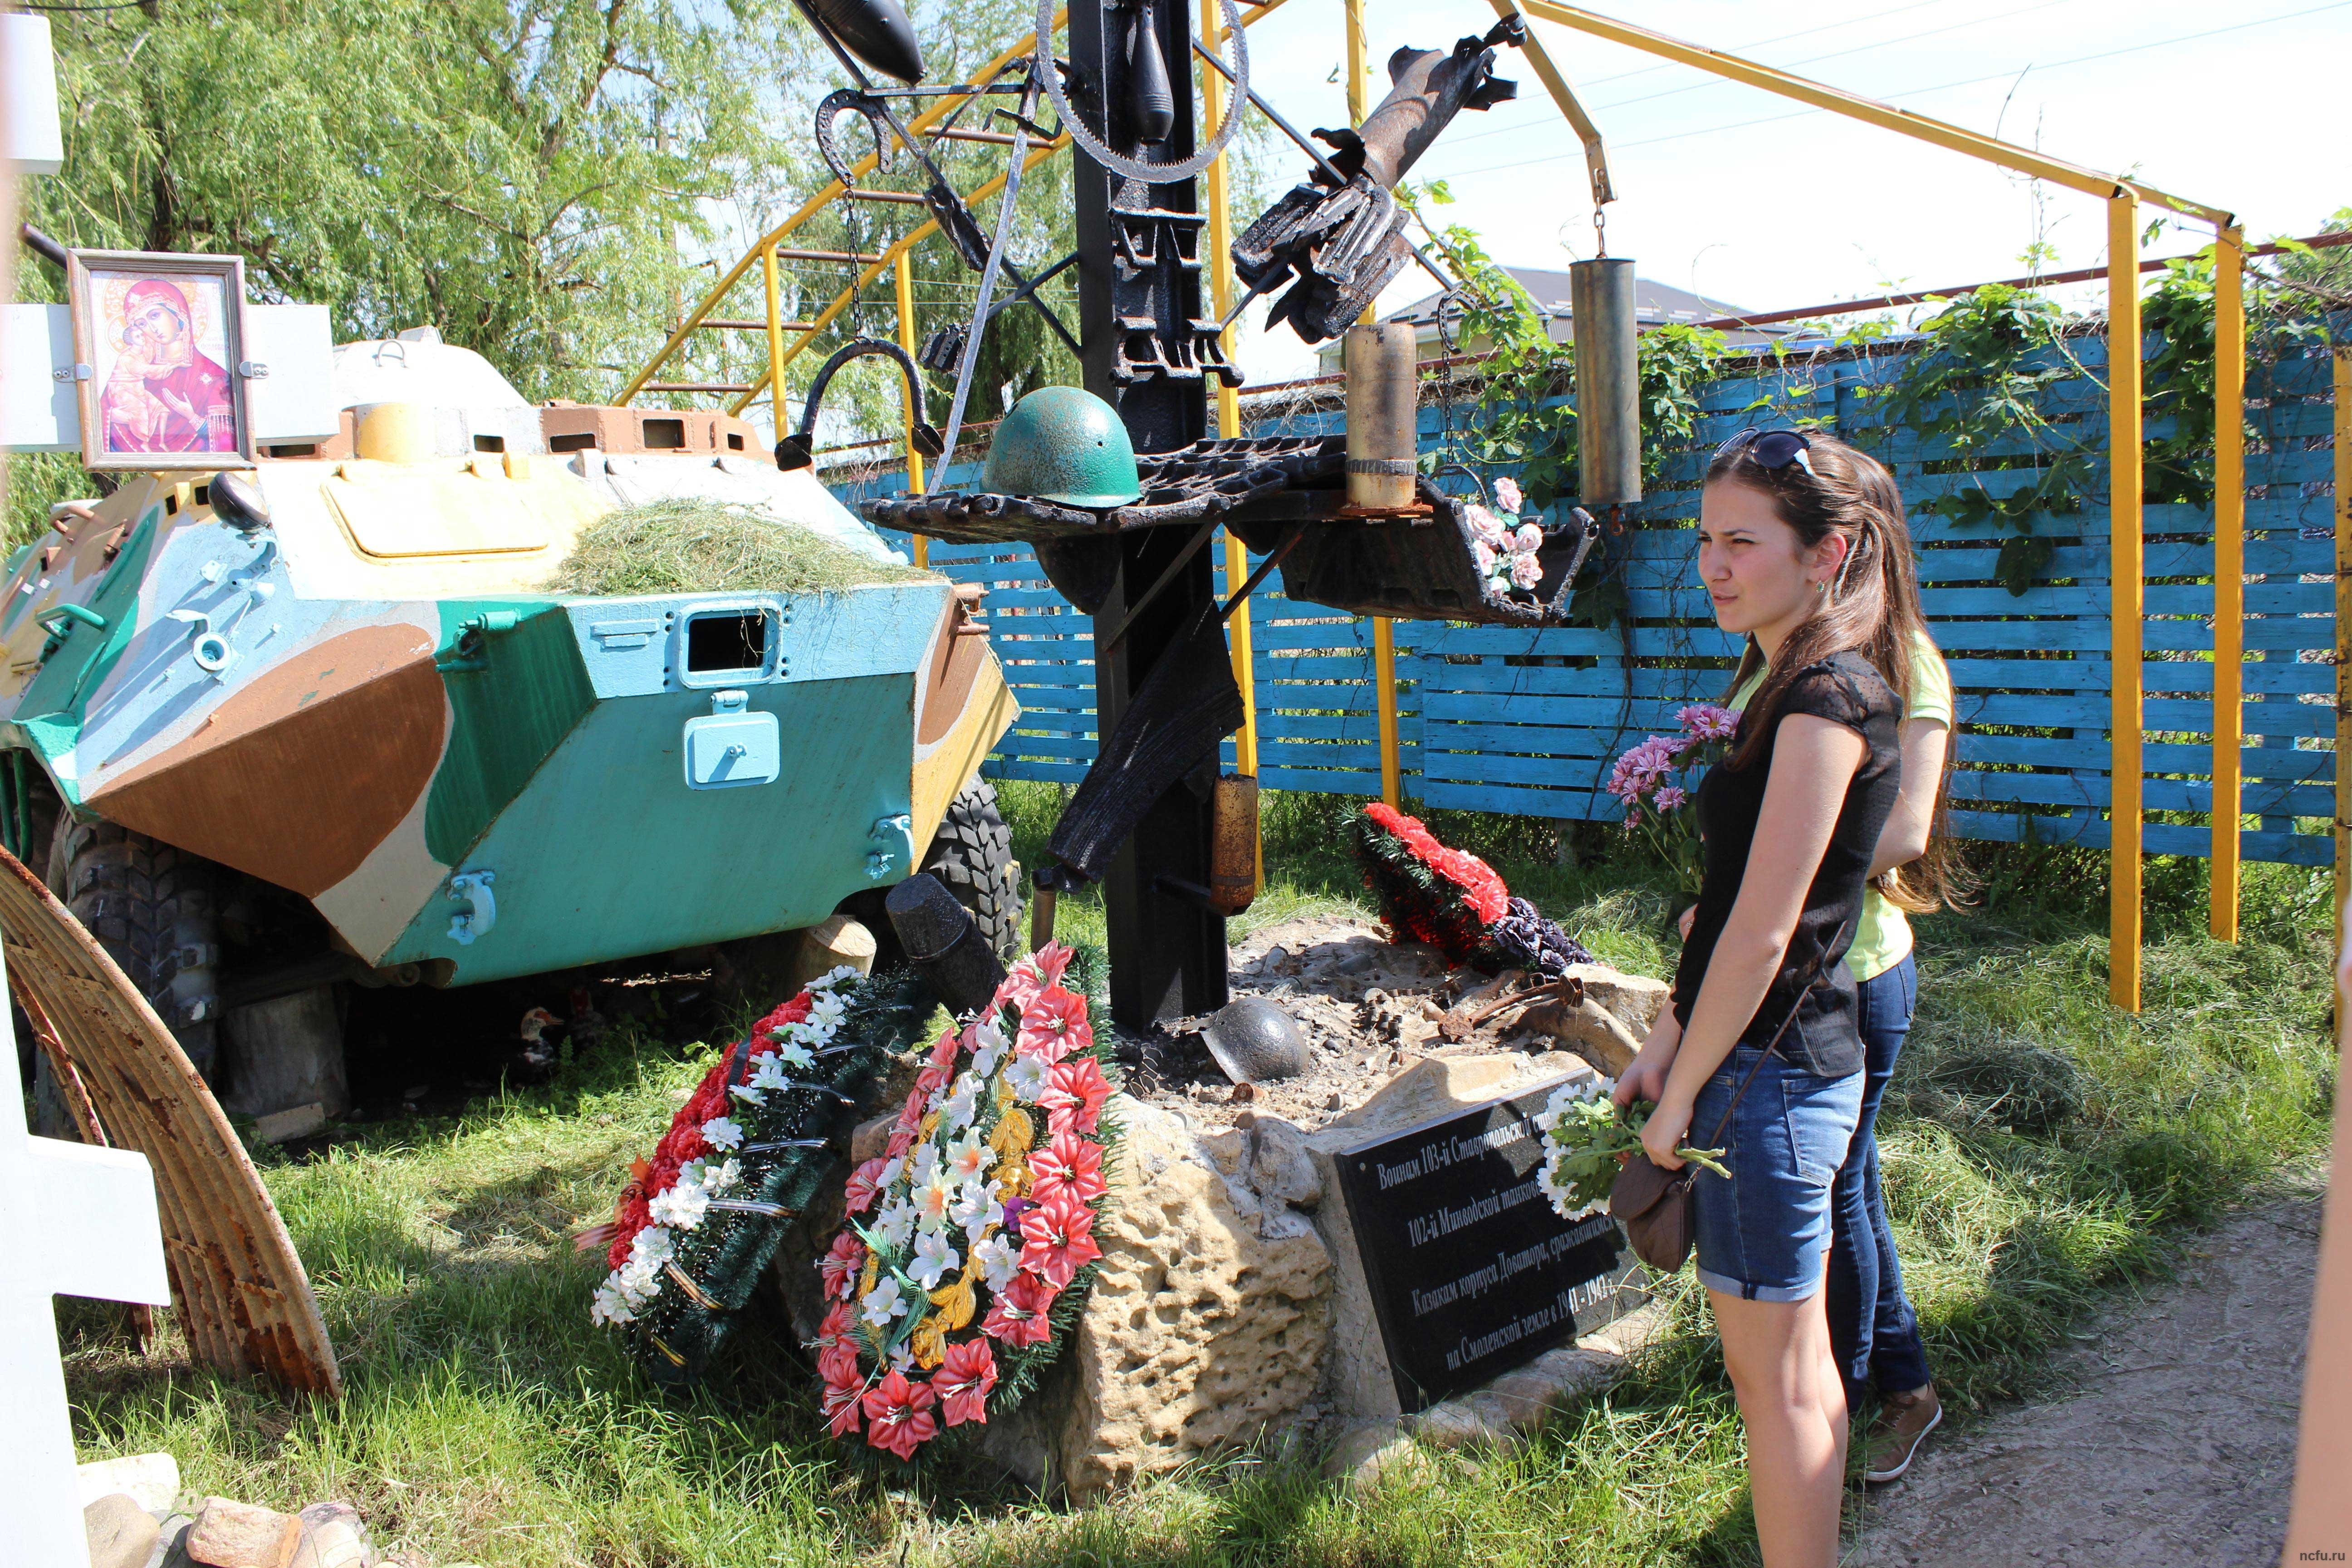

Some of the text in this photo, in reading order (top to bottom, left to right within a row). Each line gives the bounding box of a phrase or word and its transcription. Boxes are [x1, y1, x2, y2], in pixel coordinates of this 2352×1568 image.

[1377, 1161, 1421, 1190] Воинам
[1421, 1140, 1451, 1174] 103-й
[1451, 1111, 1532, 1162] Ставропольской
[1407, 1213, 1439, 1248] 102-й
[1437, 1188, 1500, 1235] Минводской
[1411, 1214, 1614, 1317] Казакам корпуса Доватора, сражавшимся
[1446, 1349, 1461, 1372] на
[1460, 1314, 1522, 1363] Смоленской
[1521, 1308, 1550, 1337] земле
[1551, 1304, 1557, 1323] в
